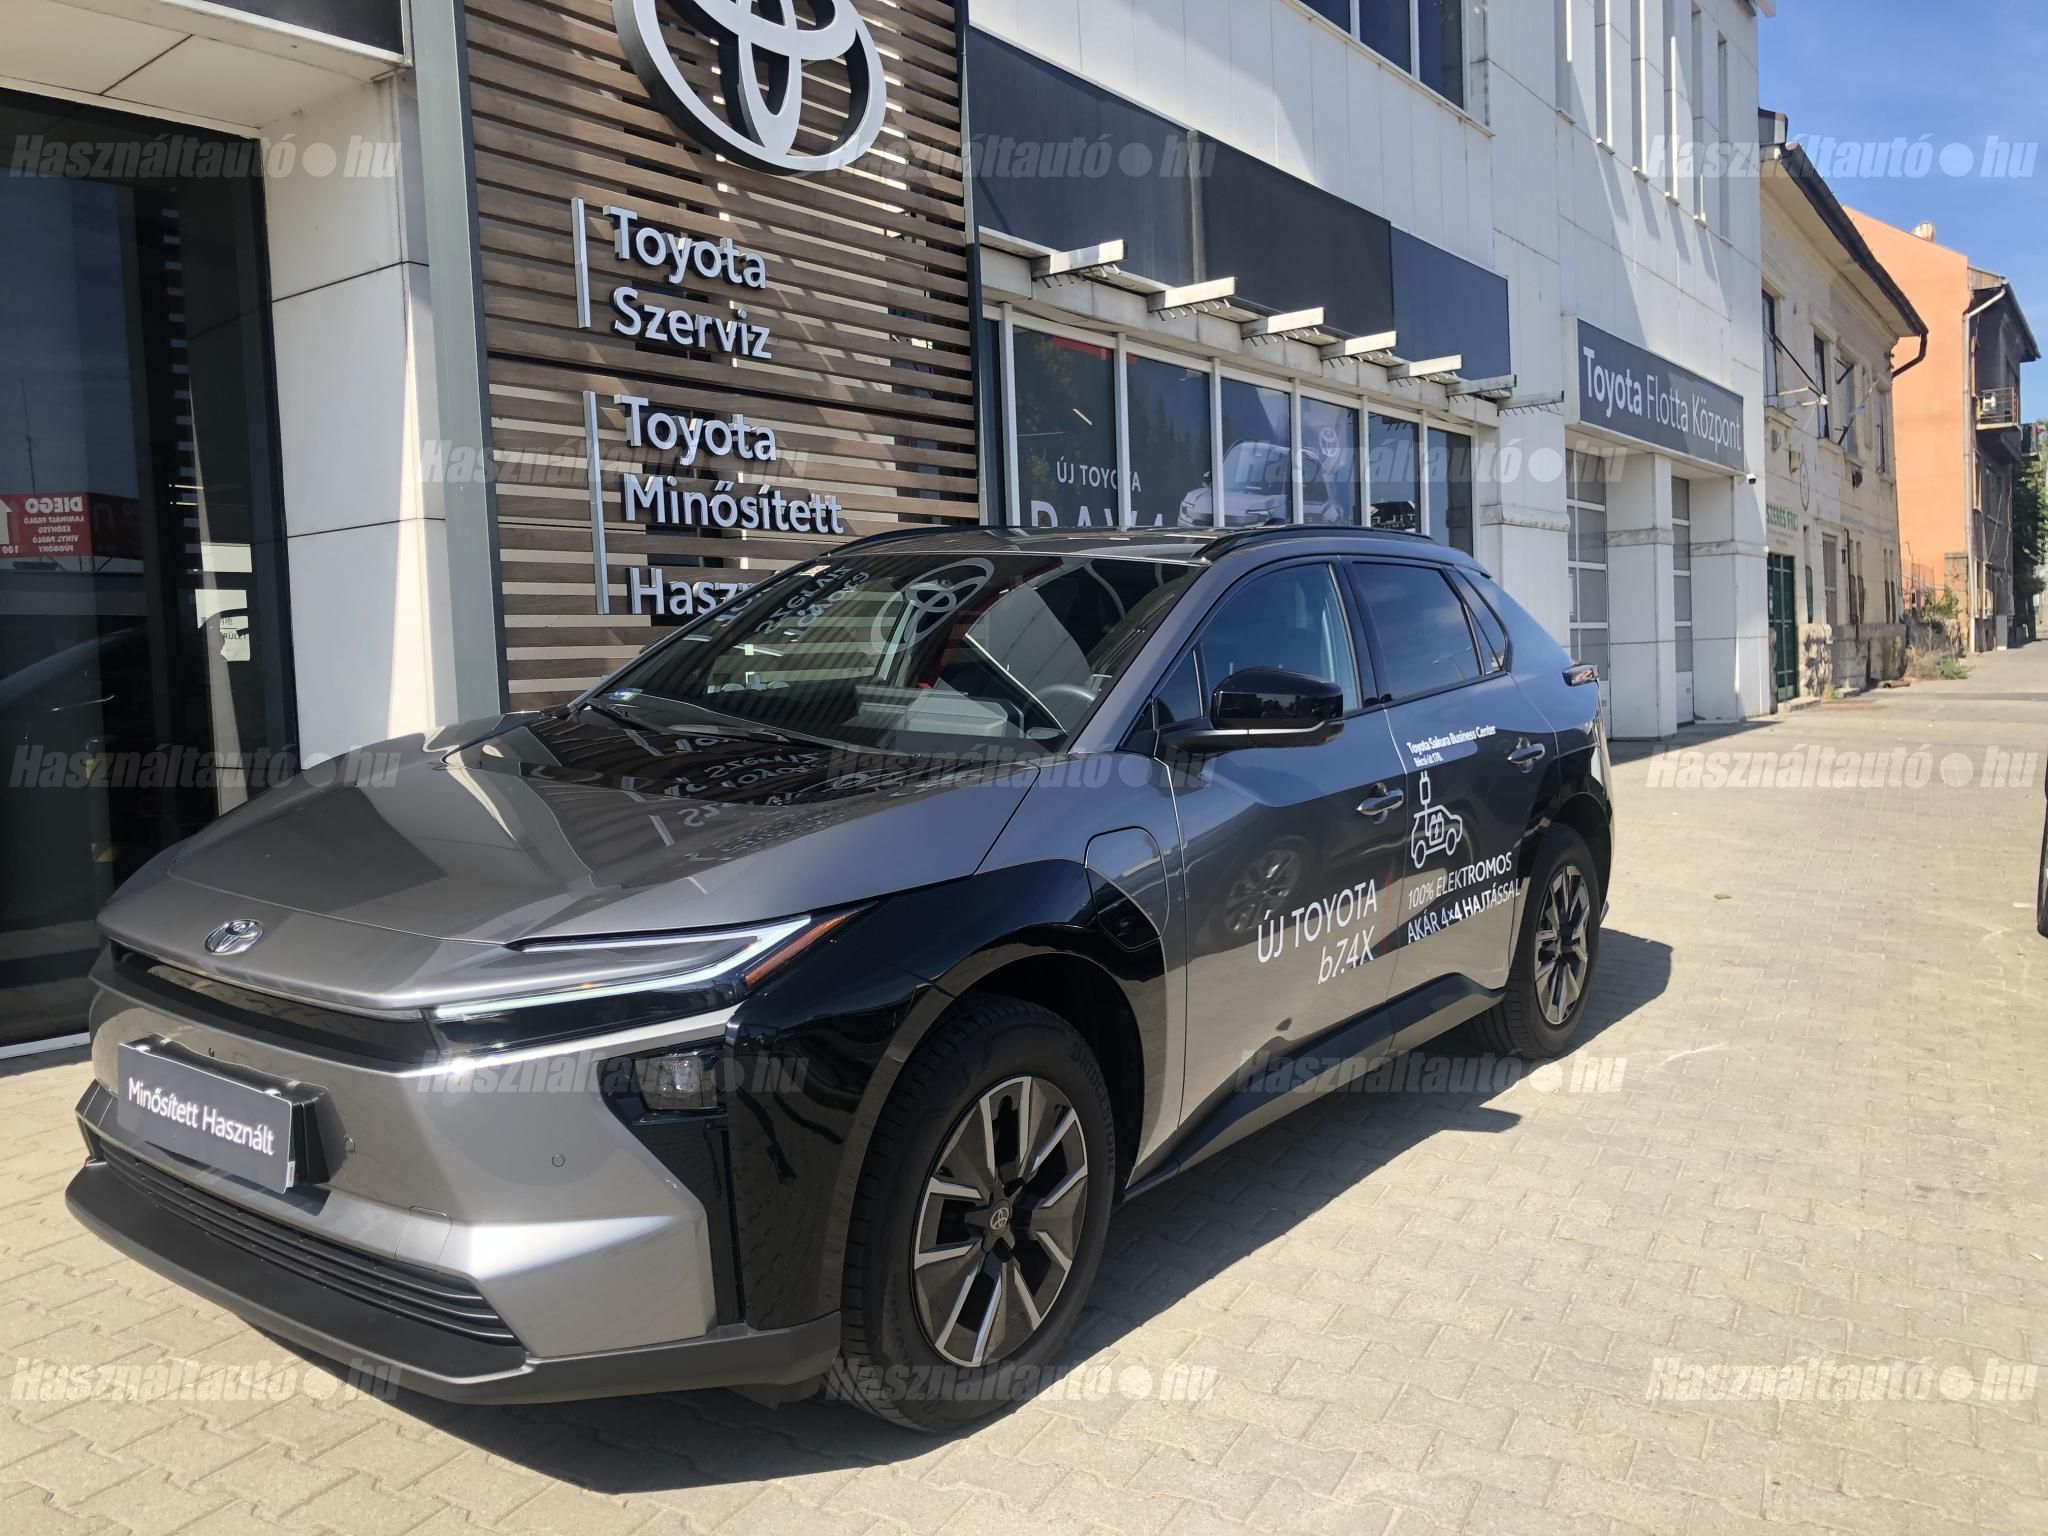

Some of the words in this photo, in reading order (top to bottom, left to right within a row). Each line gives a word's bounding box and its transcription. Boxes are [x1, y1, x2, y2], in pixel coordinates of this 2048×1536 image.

[603, 204, 766, 289] Toyota
[613, 286, 772, 360] Szerviz
[614, 394, 776, 466] Toyota
[1584, 346, 1642, 418] Toyota
[1647, 373, 1689, 433] Flotta
[1692, 393, 1741, 454] Központ
[623, 473, 844, 534] Minősített
[1057, 456, 1075, 484] ÚJ
[1080, 464, 1142, 492] TOYOA
[1407, 909, 1440, 943] AKÁR
[1462, 878, 1521, 918] HAJTÁSSAL
[1408, 880, 1434, 910] 100%
[1435, 852, 1512, 898] ELEKTROMOS
[1258, 909, 1284, 963] ÚJ
[1291, 879, 1377, 948] TOYOTA
[128, 1077, 199, 1128] Minősített
[202, 1105, 275, 1156] Használt
